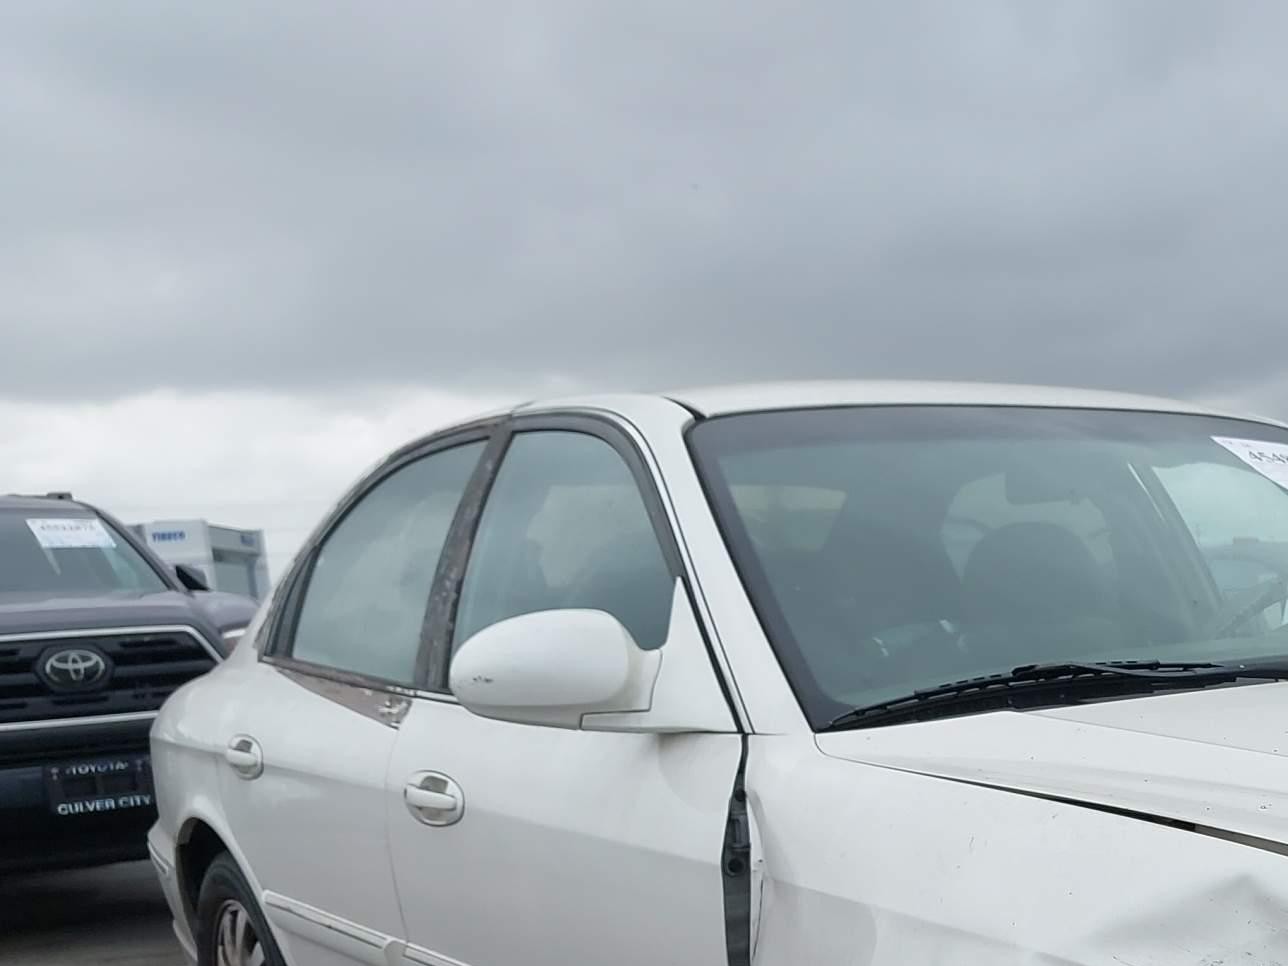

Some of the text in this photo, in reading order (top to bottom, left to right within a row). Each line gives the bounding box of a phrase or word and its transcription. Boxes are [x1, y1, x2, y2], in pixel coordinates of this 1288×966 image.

[72, 761, 127, 775] TOYOTA
[58, 794, 151, 815] CULVER CITY
